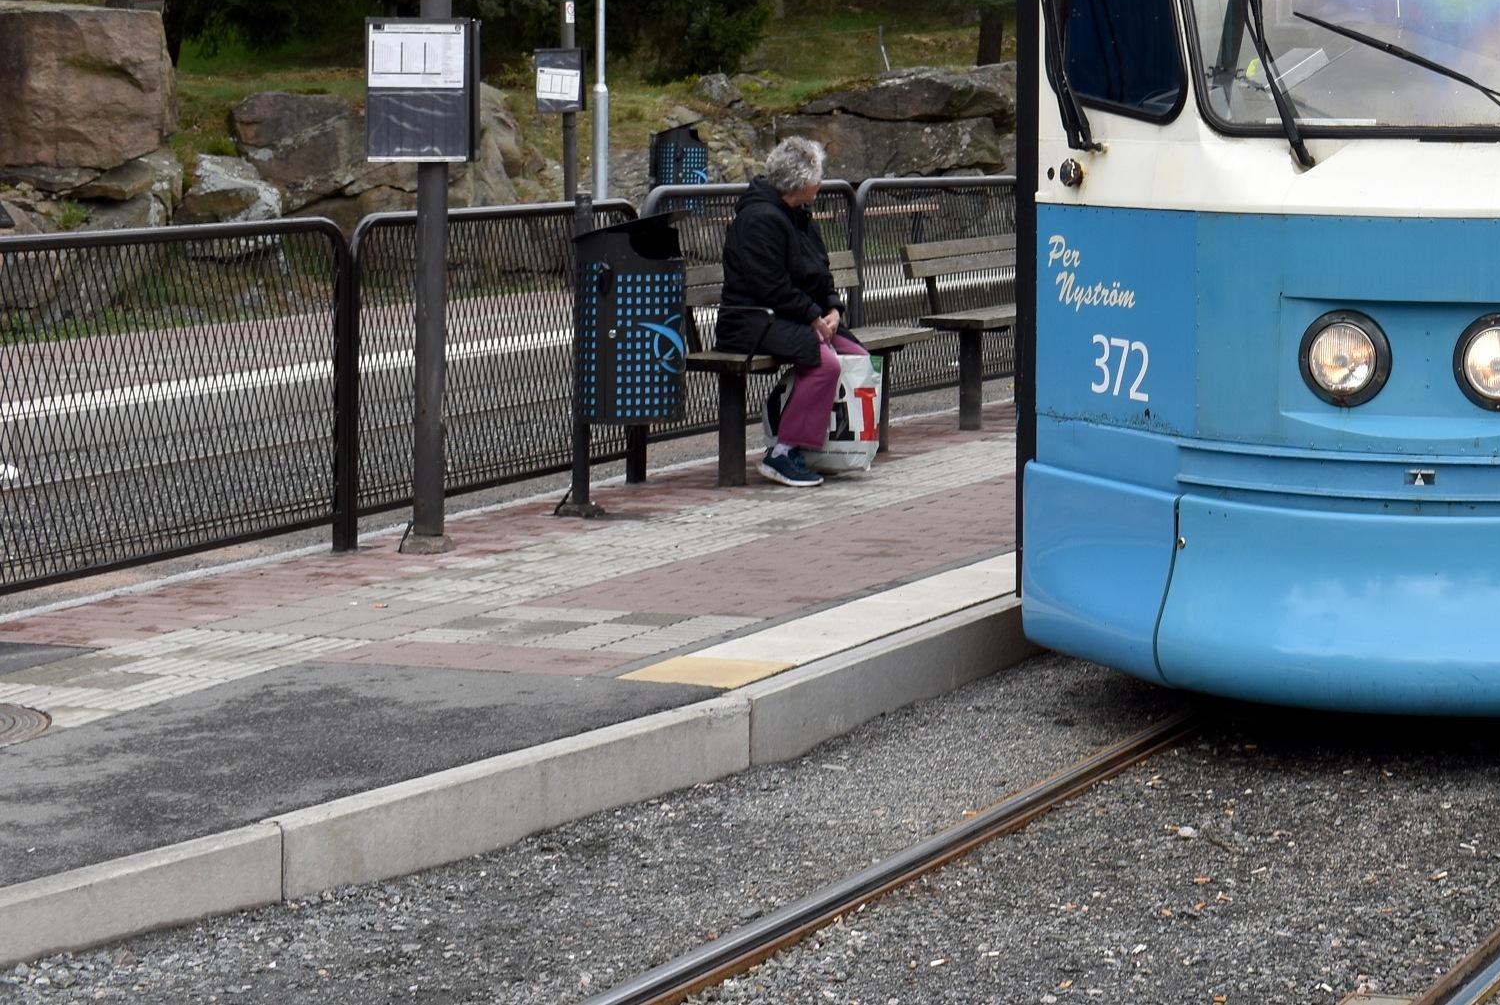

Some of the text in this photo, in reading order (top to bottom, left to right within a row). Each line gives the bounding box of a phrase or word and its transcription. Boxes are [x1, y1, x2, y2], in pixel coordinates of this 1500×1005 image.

[1048, 234, 1081, 268] Per
[1055, 270, 1136, 312] Nyström
[1091, 333, 1149, 403] 372
